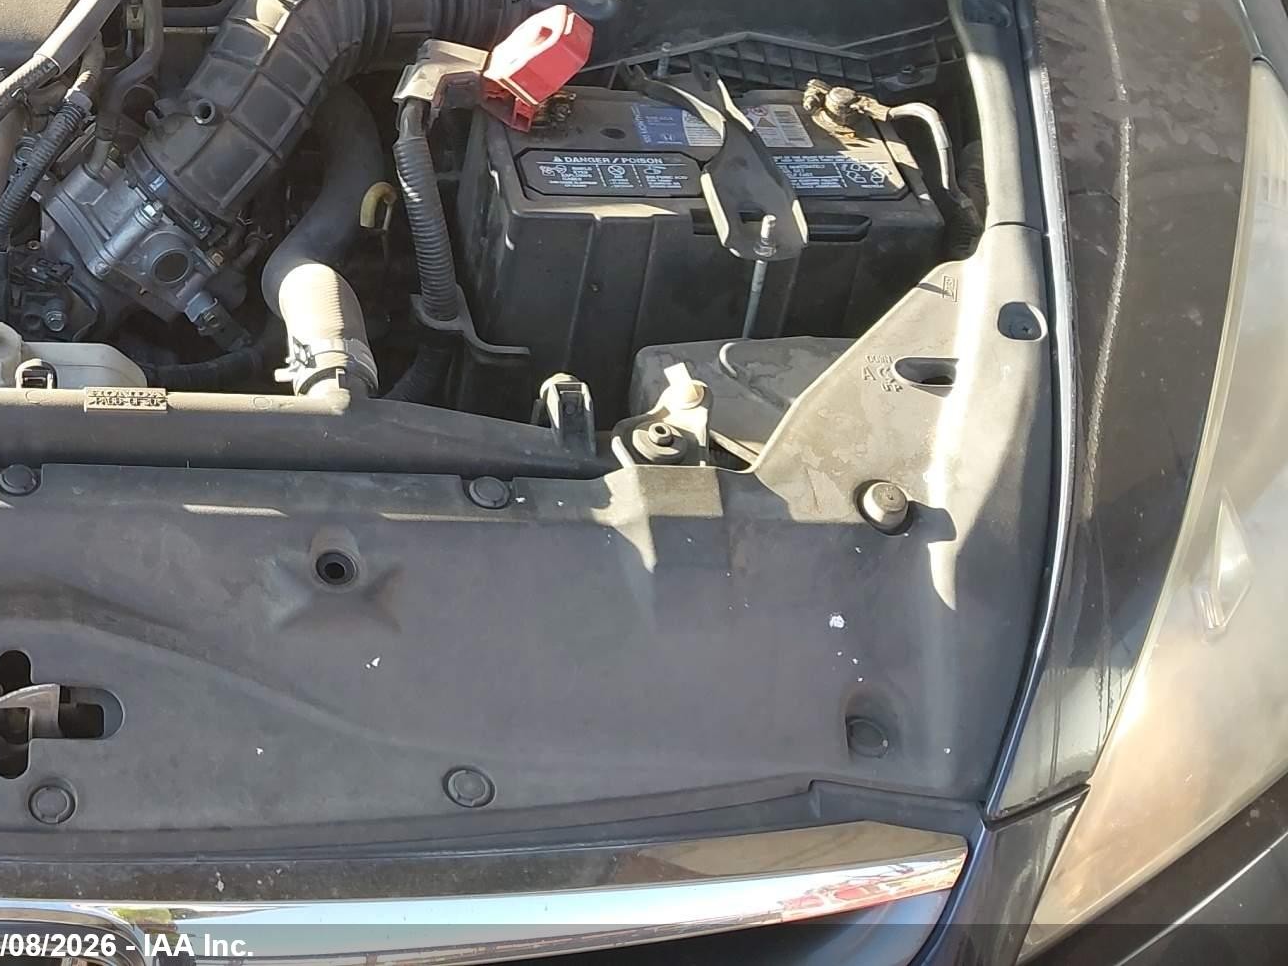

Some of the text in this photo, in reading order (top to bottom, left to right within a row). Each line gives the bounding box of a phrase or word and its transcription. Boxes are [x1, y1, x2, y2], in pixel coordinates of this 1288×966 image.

[564, 155, 610, 164] DANGER
[621, 157, 664, 165] POISON
[88, 389, 166, 398] HONDA
